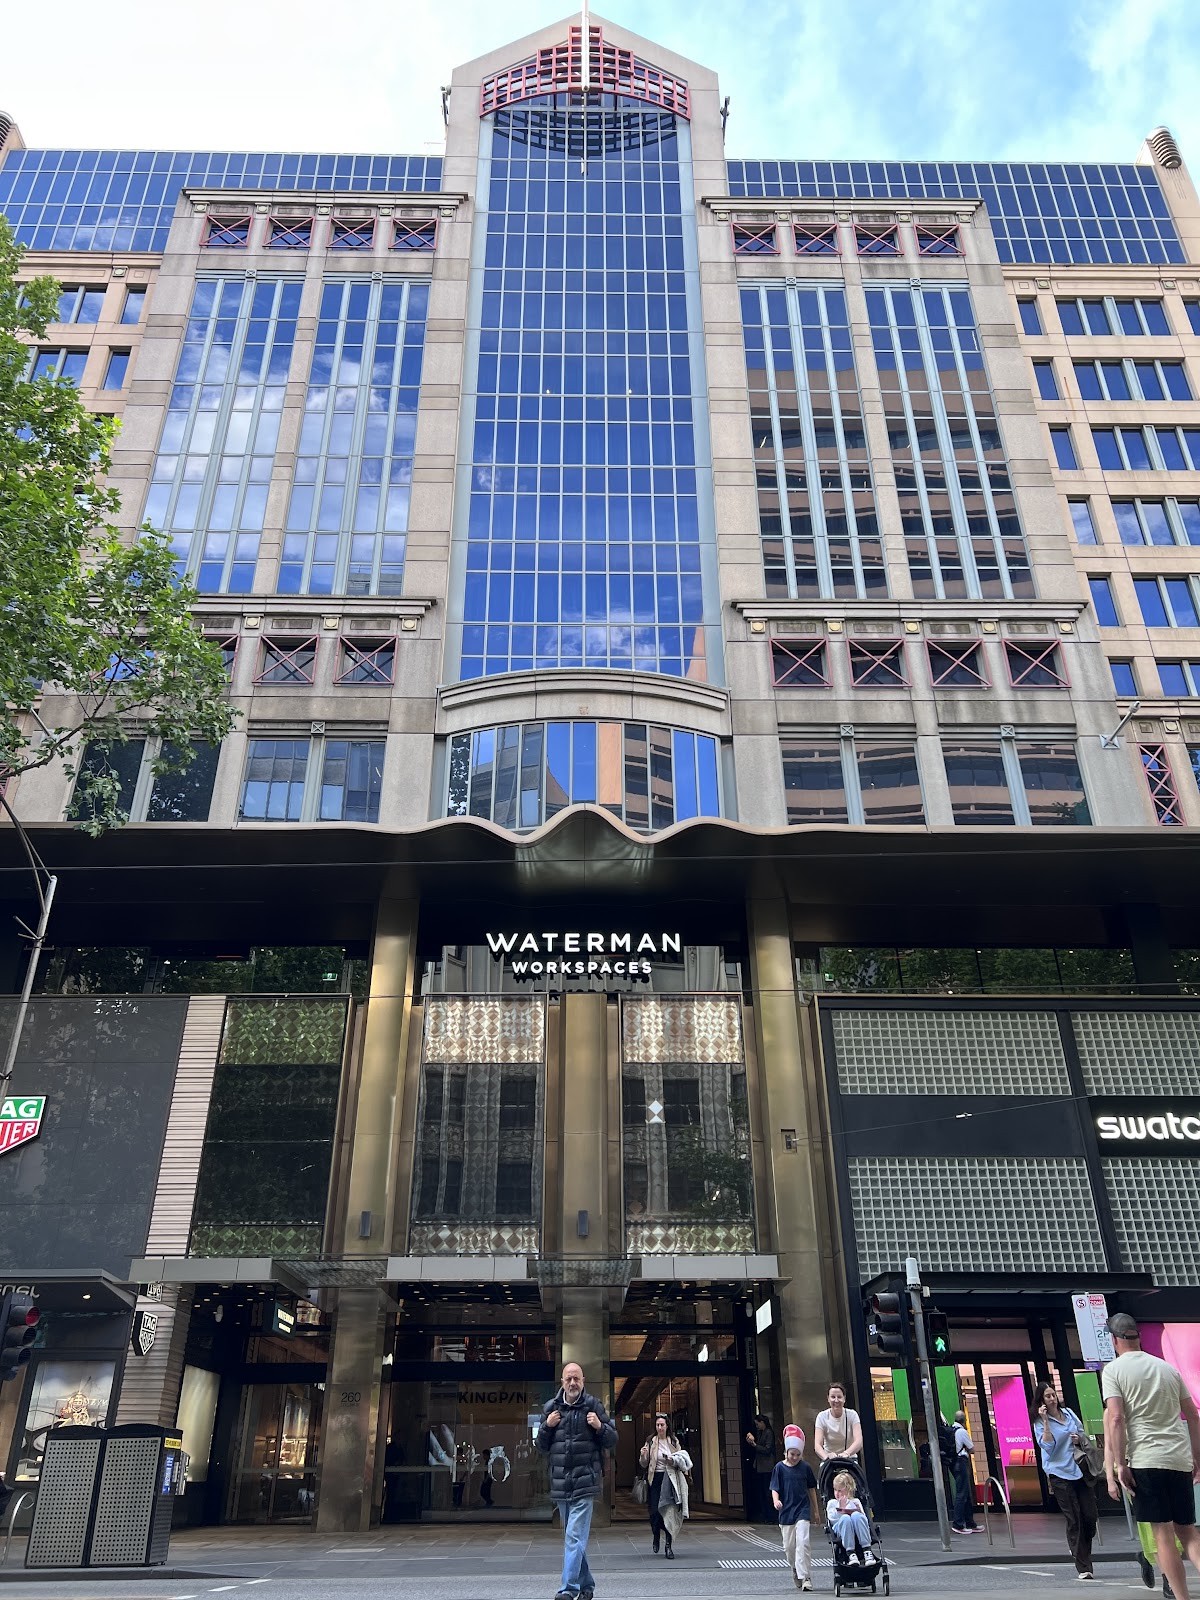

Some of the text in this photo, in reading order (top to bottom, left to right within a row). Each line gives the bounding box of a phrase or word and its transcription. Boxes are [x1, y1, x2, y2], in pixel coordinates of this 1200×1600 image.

[486, 932, 681, 953] WATERMAN
[511, 961, 653, 974] WORKSPACES
[0, 1100, 38, 1118] AG
[1097, 1112, 1200, 1140] swatc
[0, 1122, 36, 1150] UER
[143, 1315, 156, 1331] TAG
[341, 1391, 361, 1403] 260
[1005, 1435, 1029, 1443] swatch
